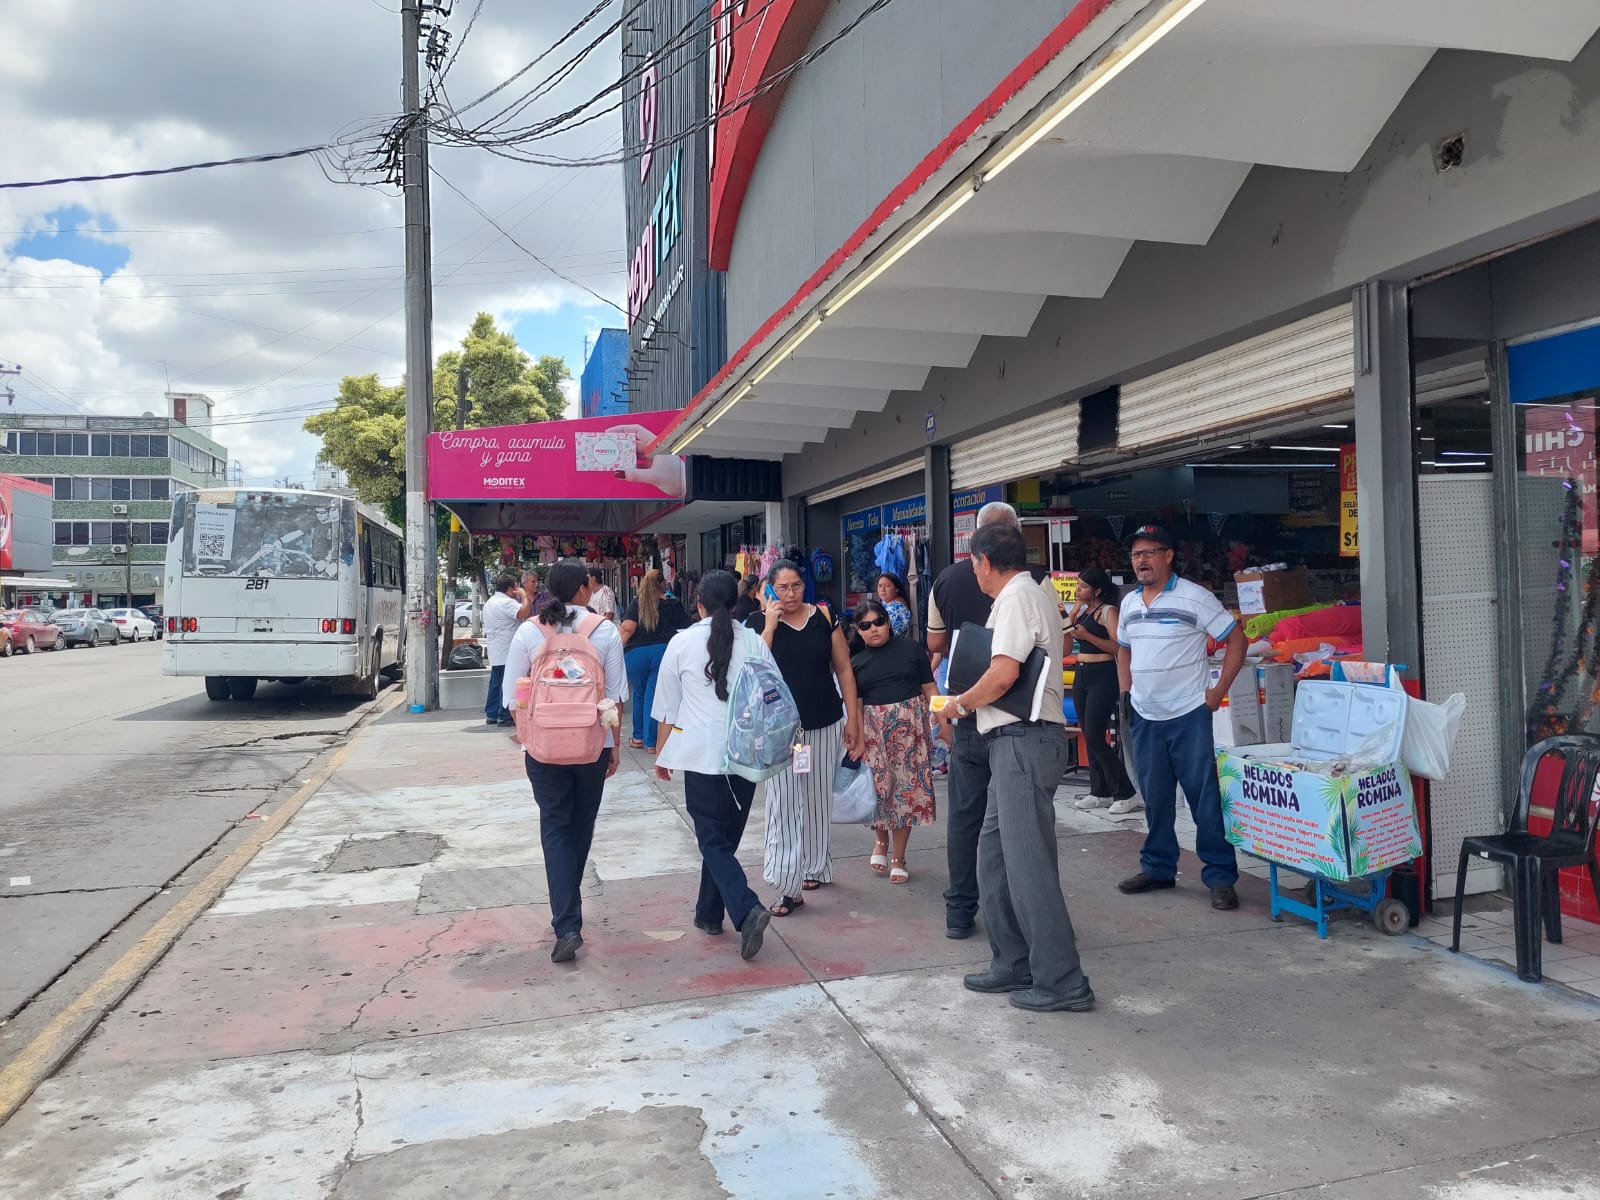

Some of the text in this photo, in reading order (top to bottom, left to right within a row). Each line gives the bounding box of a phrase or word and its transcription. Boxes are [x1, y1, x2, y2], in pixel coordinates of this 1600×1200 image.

[627, 146, 683, 335] MODITEX
[439, 432, 566, 453] Compra, acumula
[480, 451, 532, 468] y gana
[483, 477, 525, 486] MODITEX
[953, 489, 986, 509] ecoración
[245, 579, 270, 590] 281
[1243, 764, 1293, 789] HELADOS
[1358, 768, 1397, 791] HELADOS
[1242, 780, 1301, 812] ROMINA
[1357, 781, 1402, 809] ROMINA
